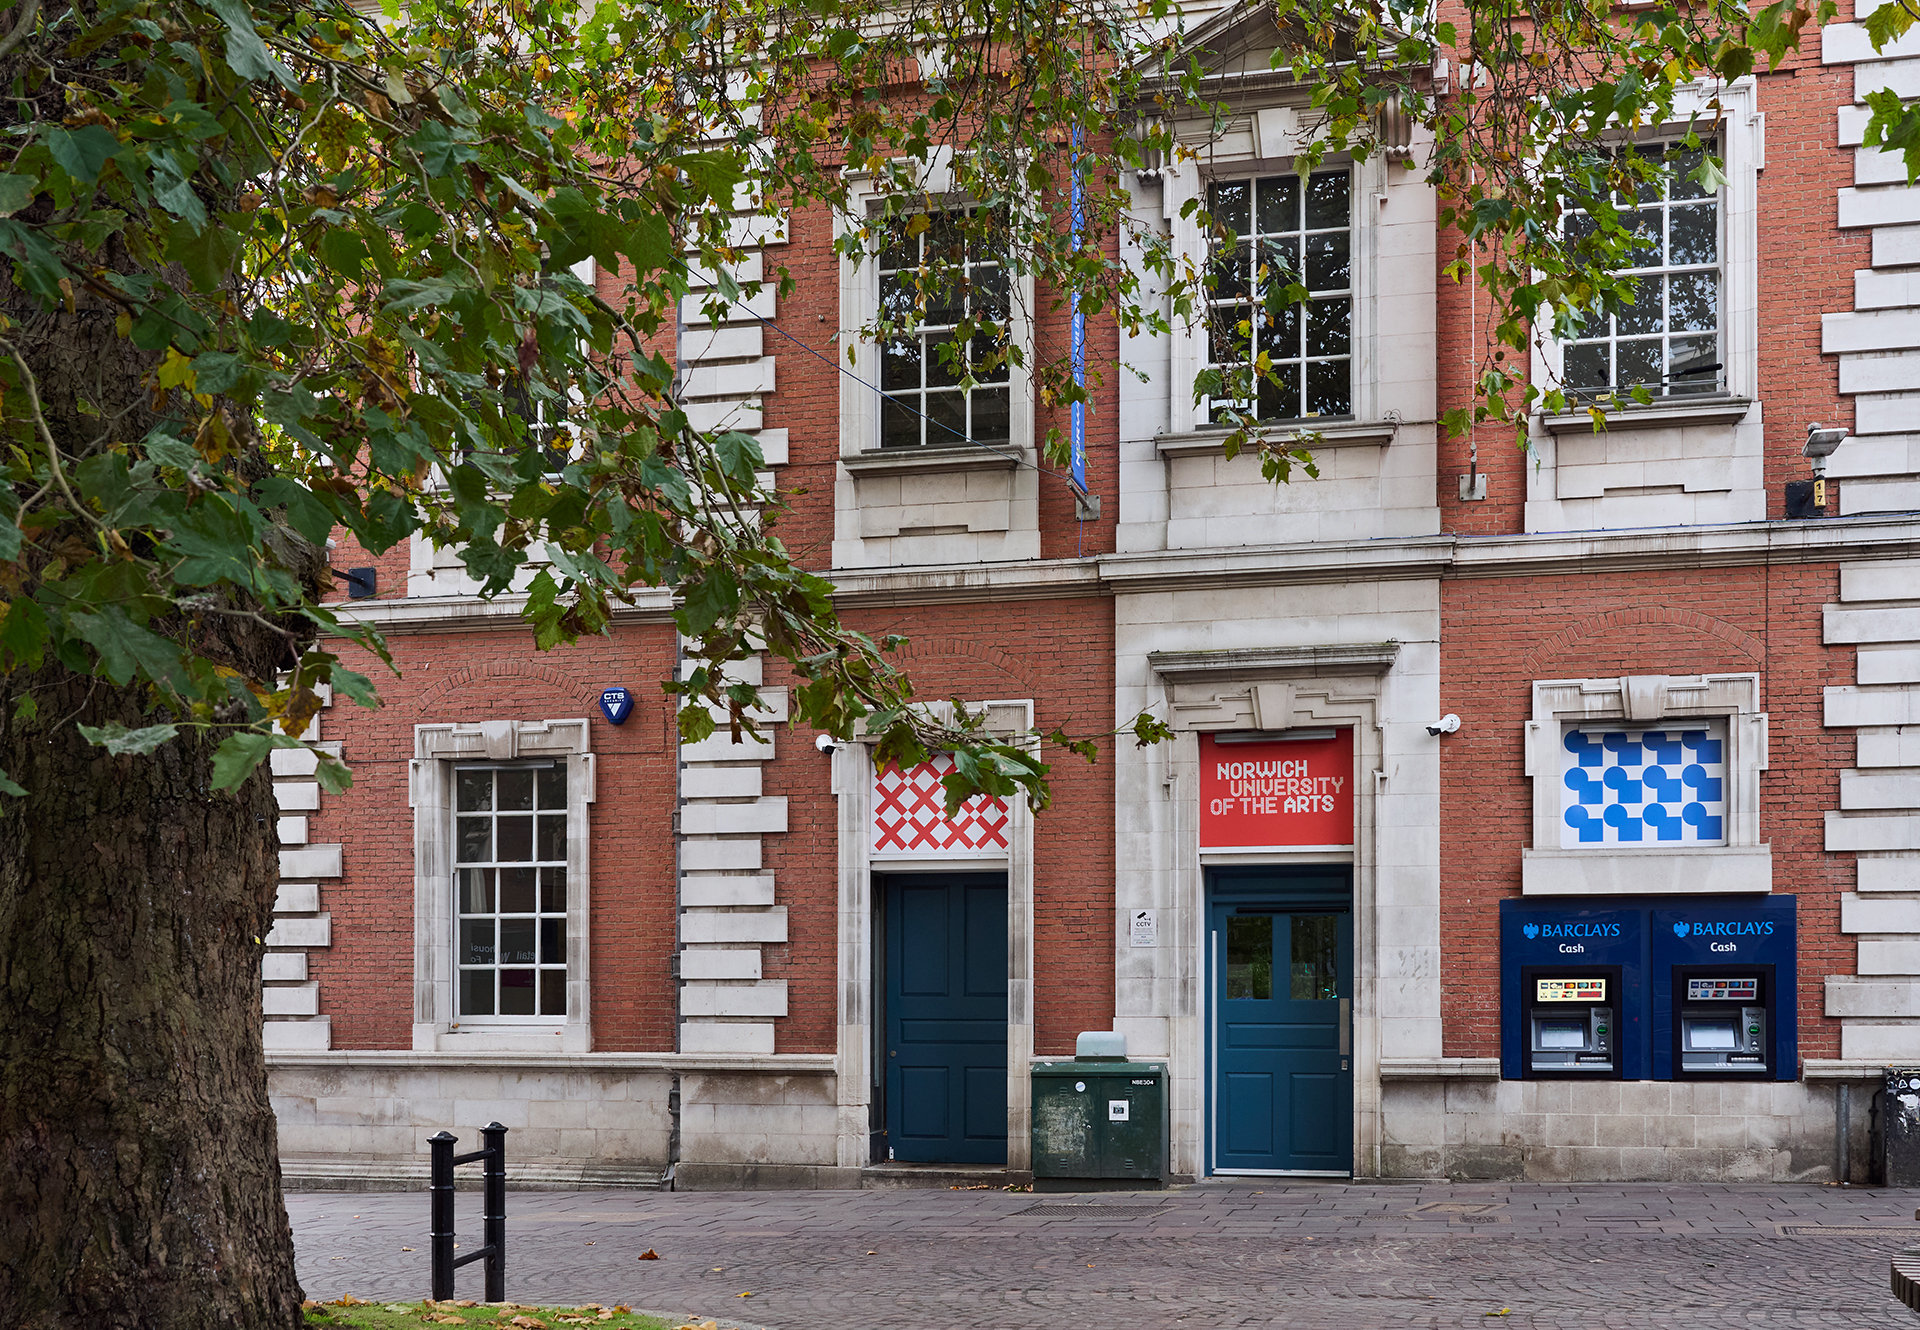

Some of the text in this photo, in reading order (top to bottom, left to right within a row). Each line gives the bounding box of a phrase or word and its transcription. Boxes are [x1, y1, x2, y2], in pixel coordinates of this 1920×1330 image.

[1217, 760, 1307, 780] NORWICH
[1230, 777, 1343, 797] UNIVERSITY
[1210, 795, 1334, 815] OF THE ARTS
[1542, 923, 1620, 938] BARCLAYS
[1693, 921, 1774, 936] BARCLAYS
[1559, 943, 1585, 954] Cash
[1710, 941, 1737, 952] Cash
